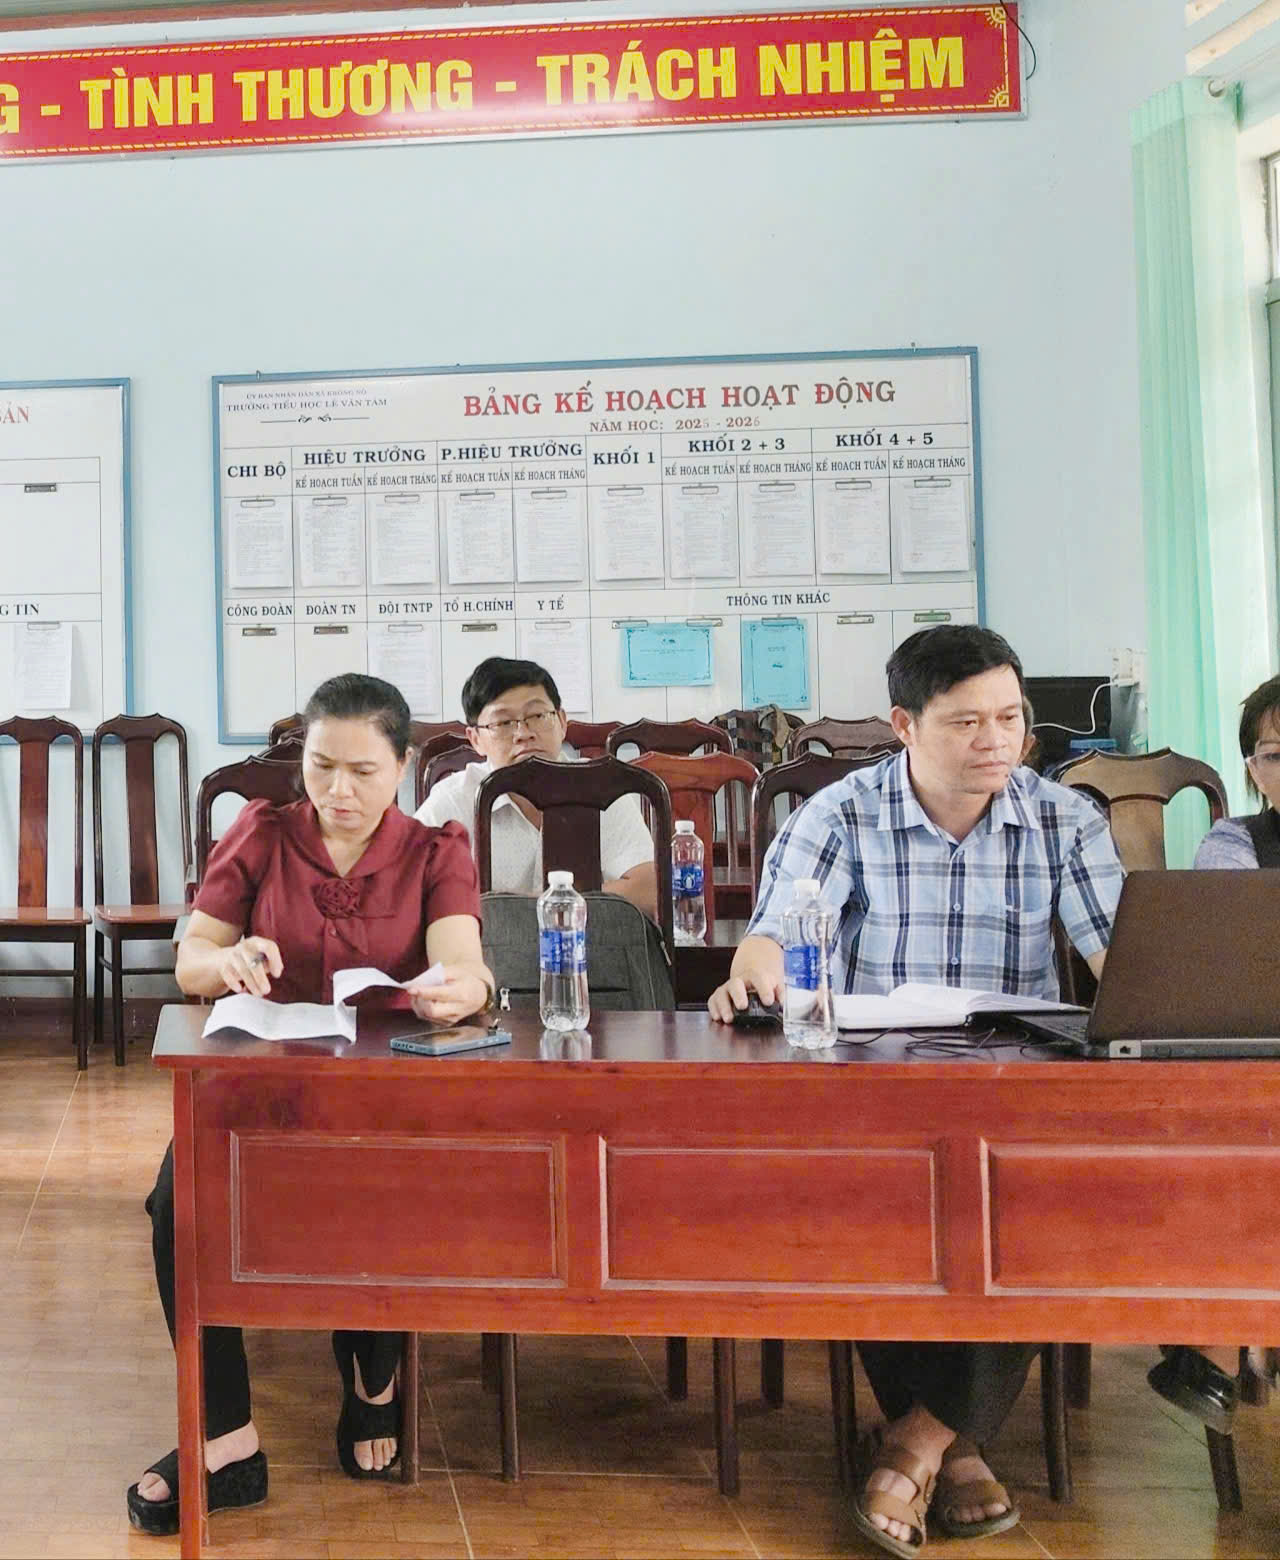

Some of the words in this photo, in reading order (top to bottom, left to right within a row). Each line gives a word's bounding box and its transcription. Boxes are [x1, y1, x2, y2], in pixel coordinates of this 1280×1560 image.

[79, 67, 213, 129] TÌNH
[233, 58, 473, 121] THƯƠNG
[536, 39, 737, 105] TRÁCH
[760, 28, 964, 103] NHIỆM
[464, 386, 542, 417] BẢNG
[554, 380, 594, 413] KẾ
[605, 386, 706, 413] HOẠCH
[721, 384, 800, 411] HOẠT
[815, 376, 896, 410] ĐỘNG
[589, 418, 622, 432] NĂM
[628, 420, 664, 433] HỌC:
[726, 416, 760, 428] 2026
[688, 433, 735, 452] KHỐI
[741, 439, 751, 451] 2
[759, 441, 768, 450] +
[774, 438, 785, 450] 3
[836, 428, 882, 447] KHỐI
[889, 434, 899, 446] 4
[907, 436, 916, 445] +
[923, 432, 934, 445] 5
[304, 449, 346, 466] HIỆU
[353, 445, 426, 463] TRƯỞNG
[441, 443, 501, 462] P.HIỆU
[508, 439, 583, 458] TRƯỞNG
[593, 445, 640, 465] KHỐI
[648, 452, 656, 464] 1
[227, 465, 258, 478] CHI
[264, 460, 286, 480] BỘ
[464, 598, 514, 612] H.CHÍNH
[537, 600, 544, 610] Y
[548, 594, 565, 610] TẾ
[726, 592, 768, 607] THÔNG
[771, 594, 792, 606] TIN
[796, 590, 830, 604] KHÁC
[13, 602, 40, 616] TIN
[227, 604, 258, 616] CÔNG
[262, 602, 293, 616] ĐOÀN
[306, 602, 337, 616] ĐOÀN
[342, 604, 356, 614] TN
[378, 600, 400, 616] ĐỘI
[403, 602, 433, 614] TNTP
